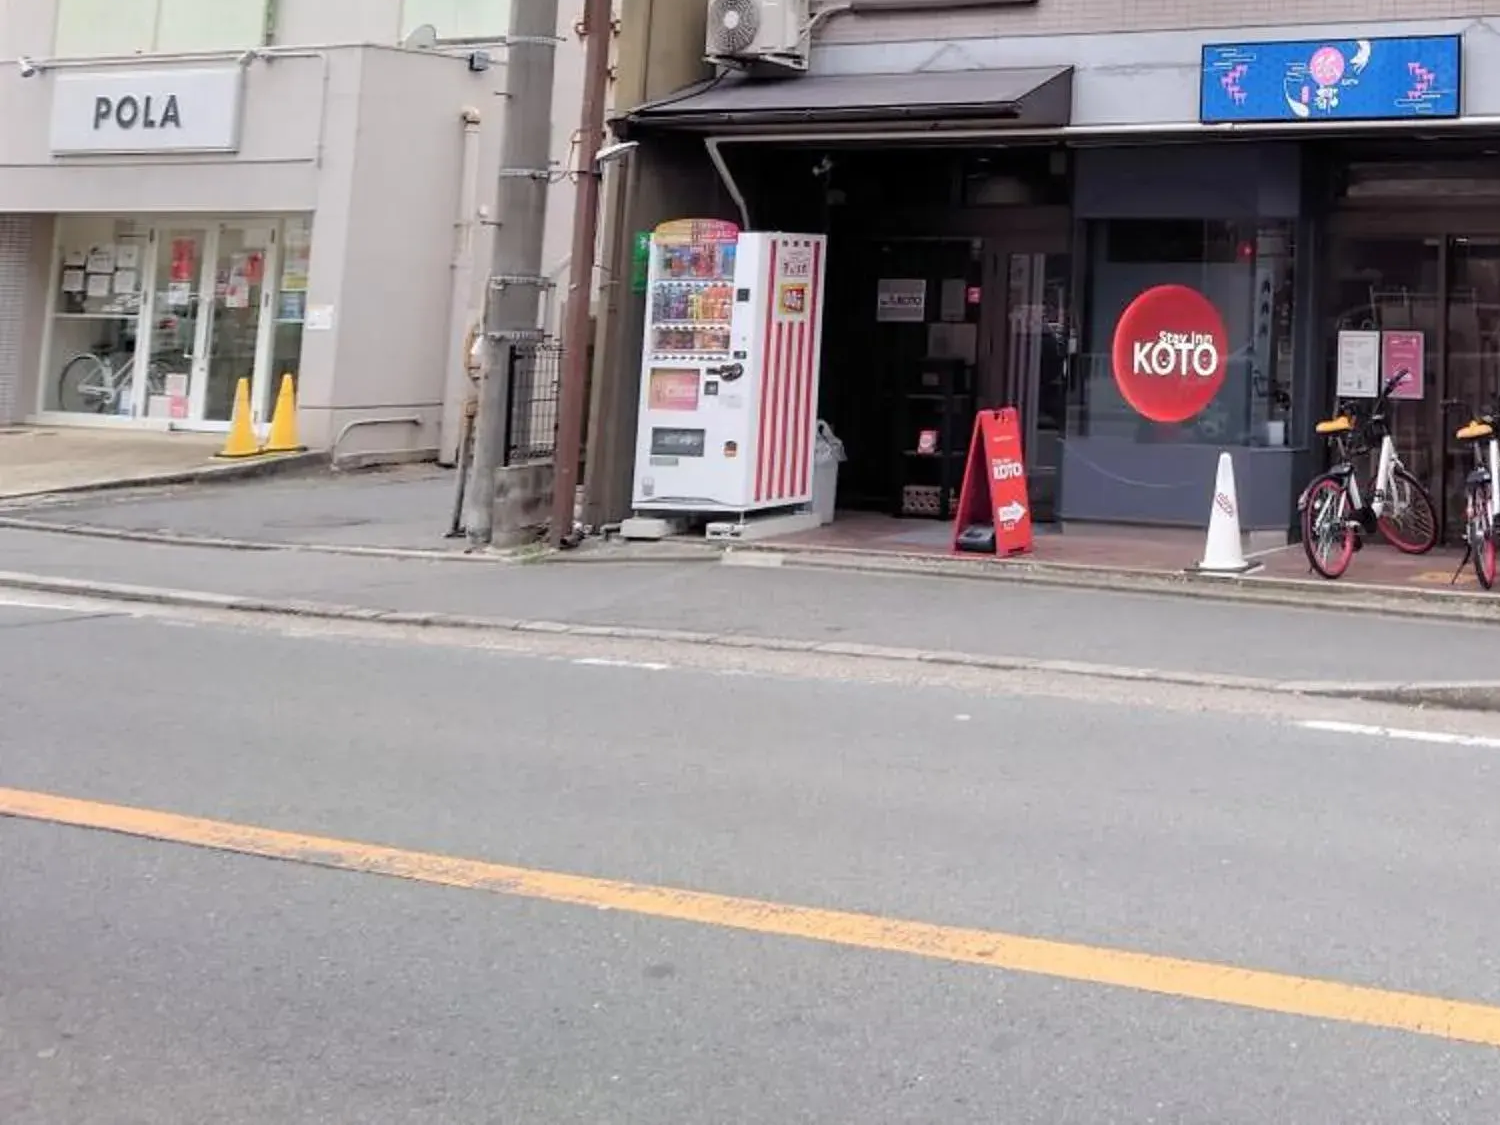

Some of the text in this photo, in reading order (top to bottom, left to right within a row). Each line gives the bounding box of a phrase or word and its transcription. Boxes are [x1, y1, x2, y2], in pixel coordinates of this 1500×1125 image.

[94, 93, 181, 130] POLA
[1159, 330, 1213, 346] Stay Inn
[1133, 340, 1218, 376] KOTO
